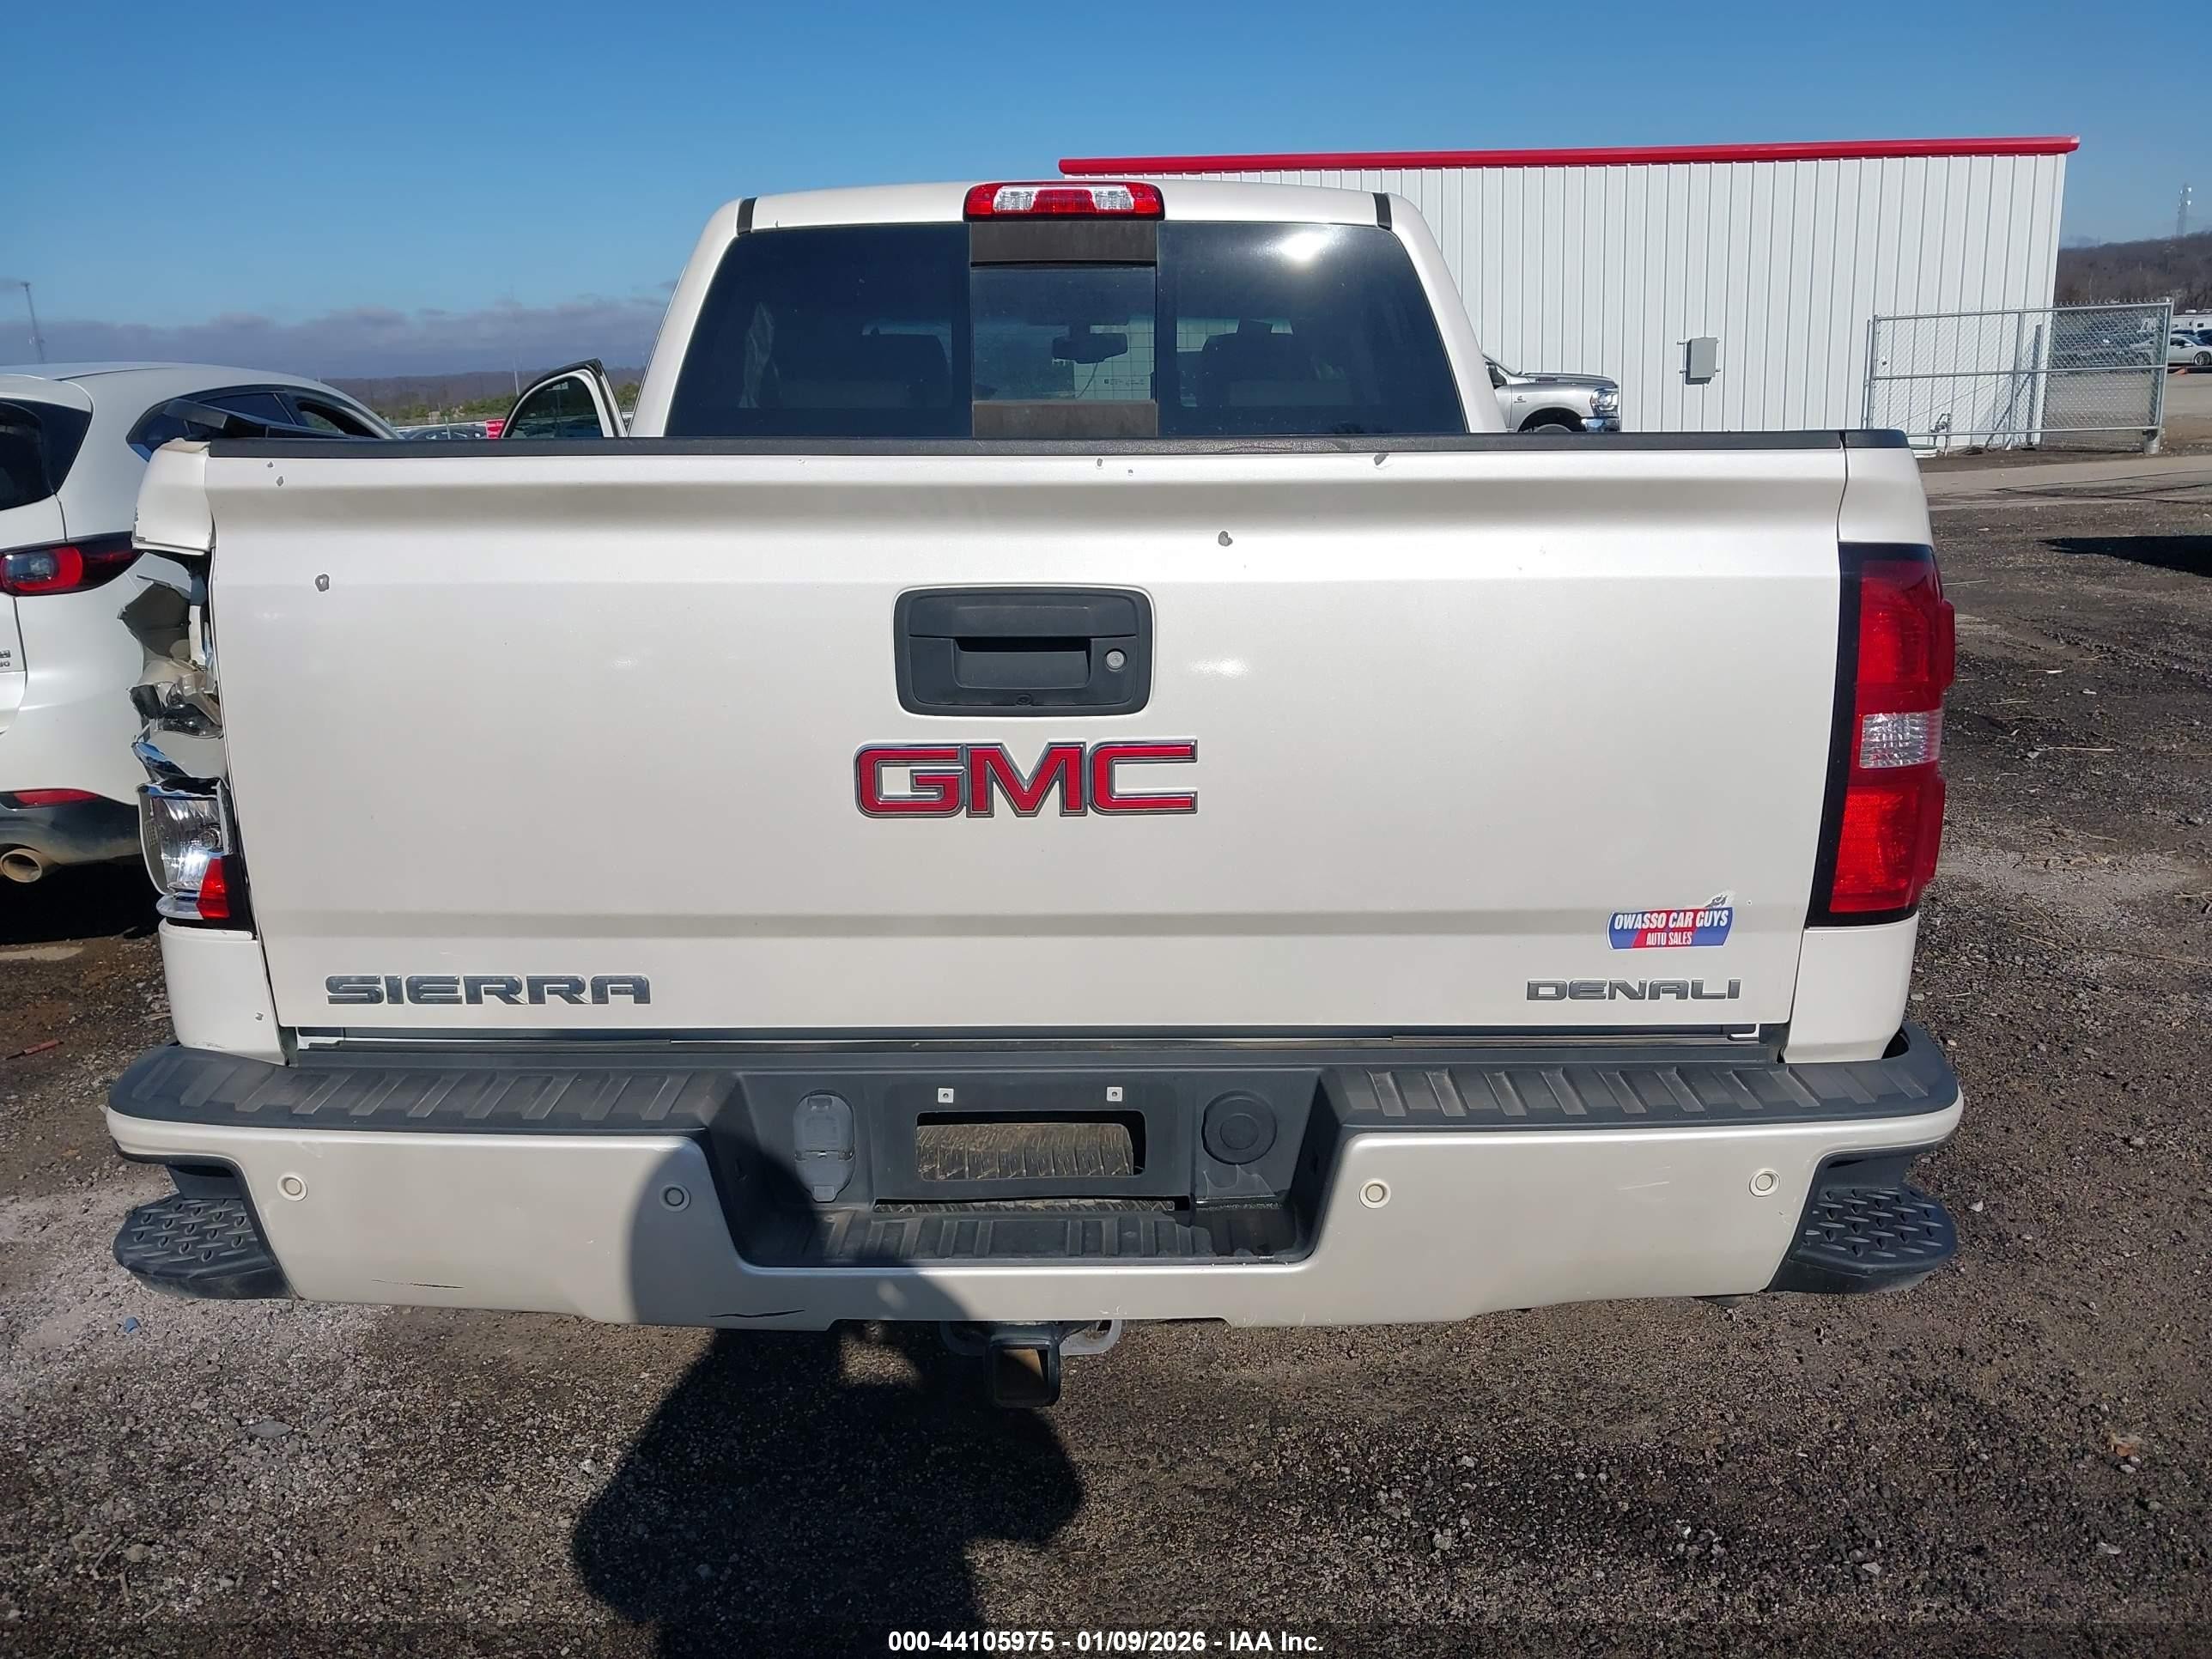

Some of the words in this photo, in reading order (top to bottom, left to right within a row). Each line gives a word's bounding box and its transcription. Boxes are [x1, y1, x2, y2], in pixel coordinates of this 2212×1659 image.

[854, 738, 1198, 818] GMC
[1613, 912, 1668, 930] OWASSO
[1668, 910, 1693, 929] CAR
[1695, 909, 1729, 928] GUYS
[1645, 931, 1668, 946] AUTO
[1668, 930, 1693, 945] SALES
[325, 975, 652, 1006] SIERRA
[1526, 978, 1741, 1001] DENALI
